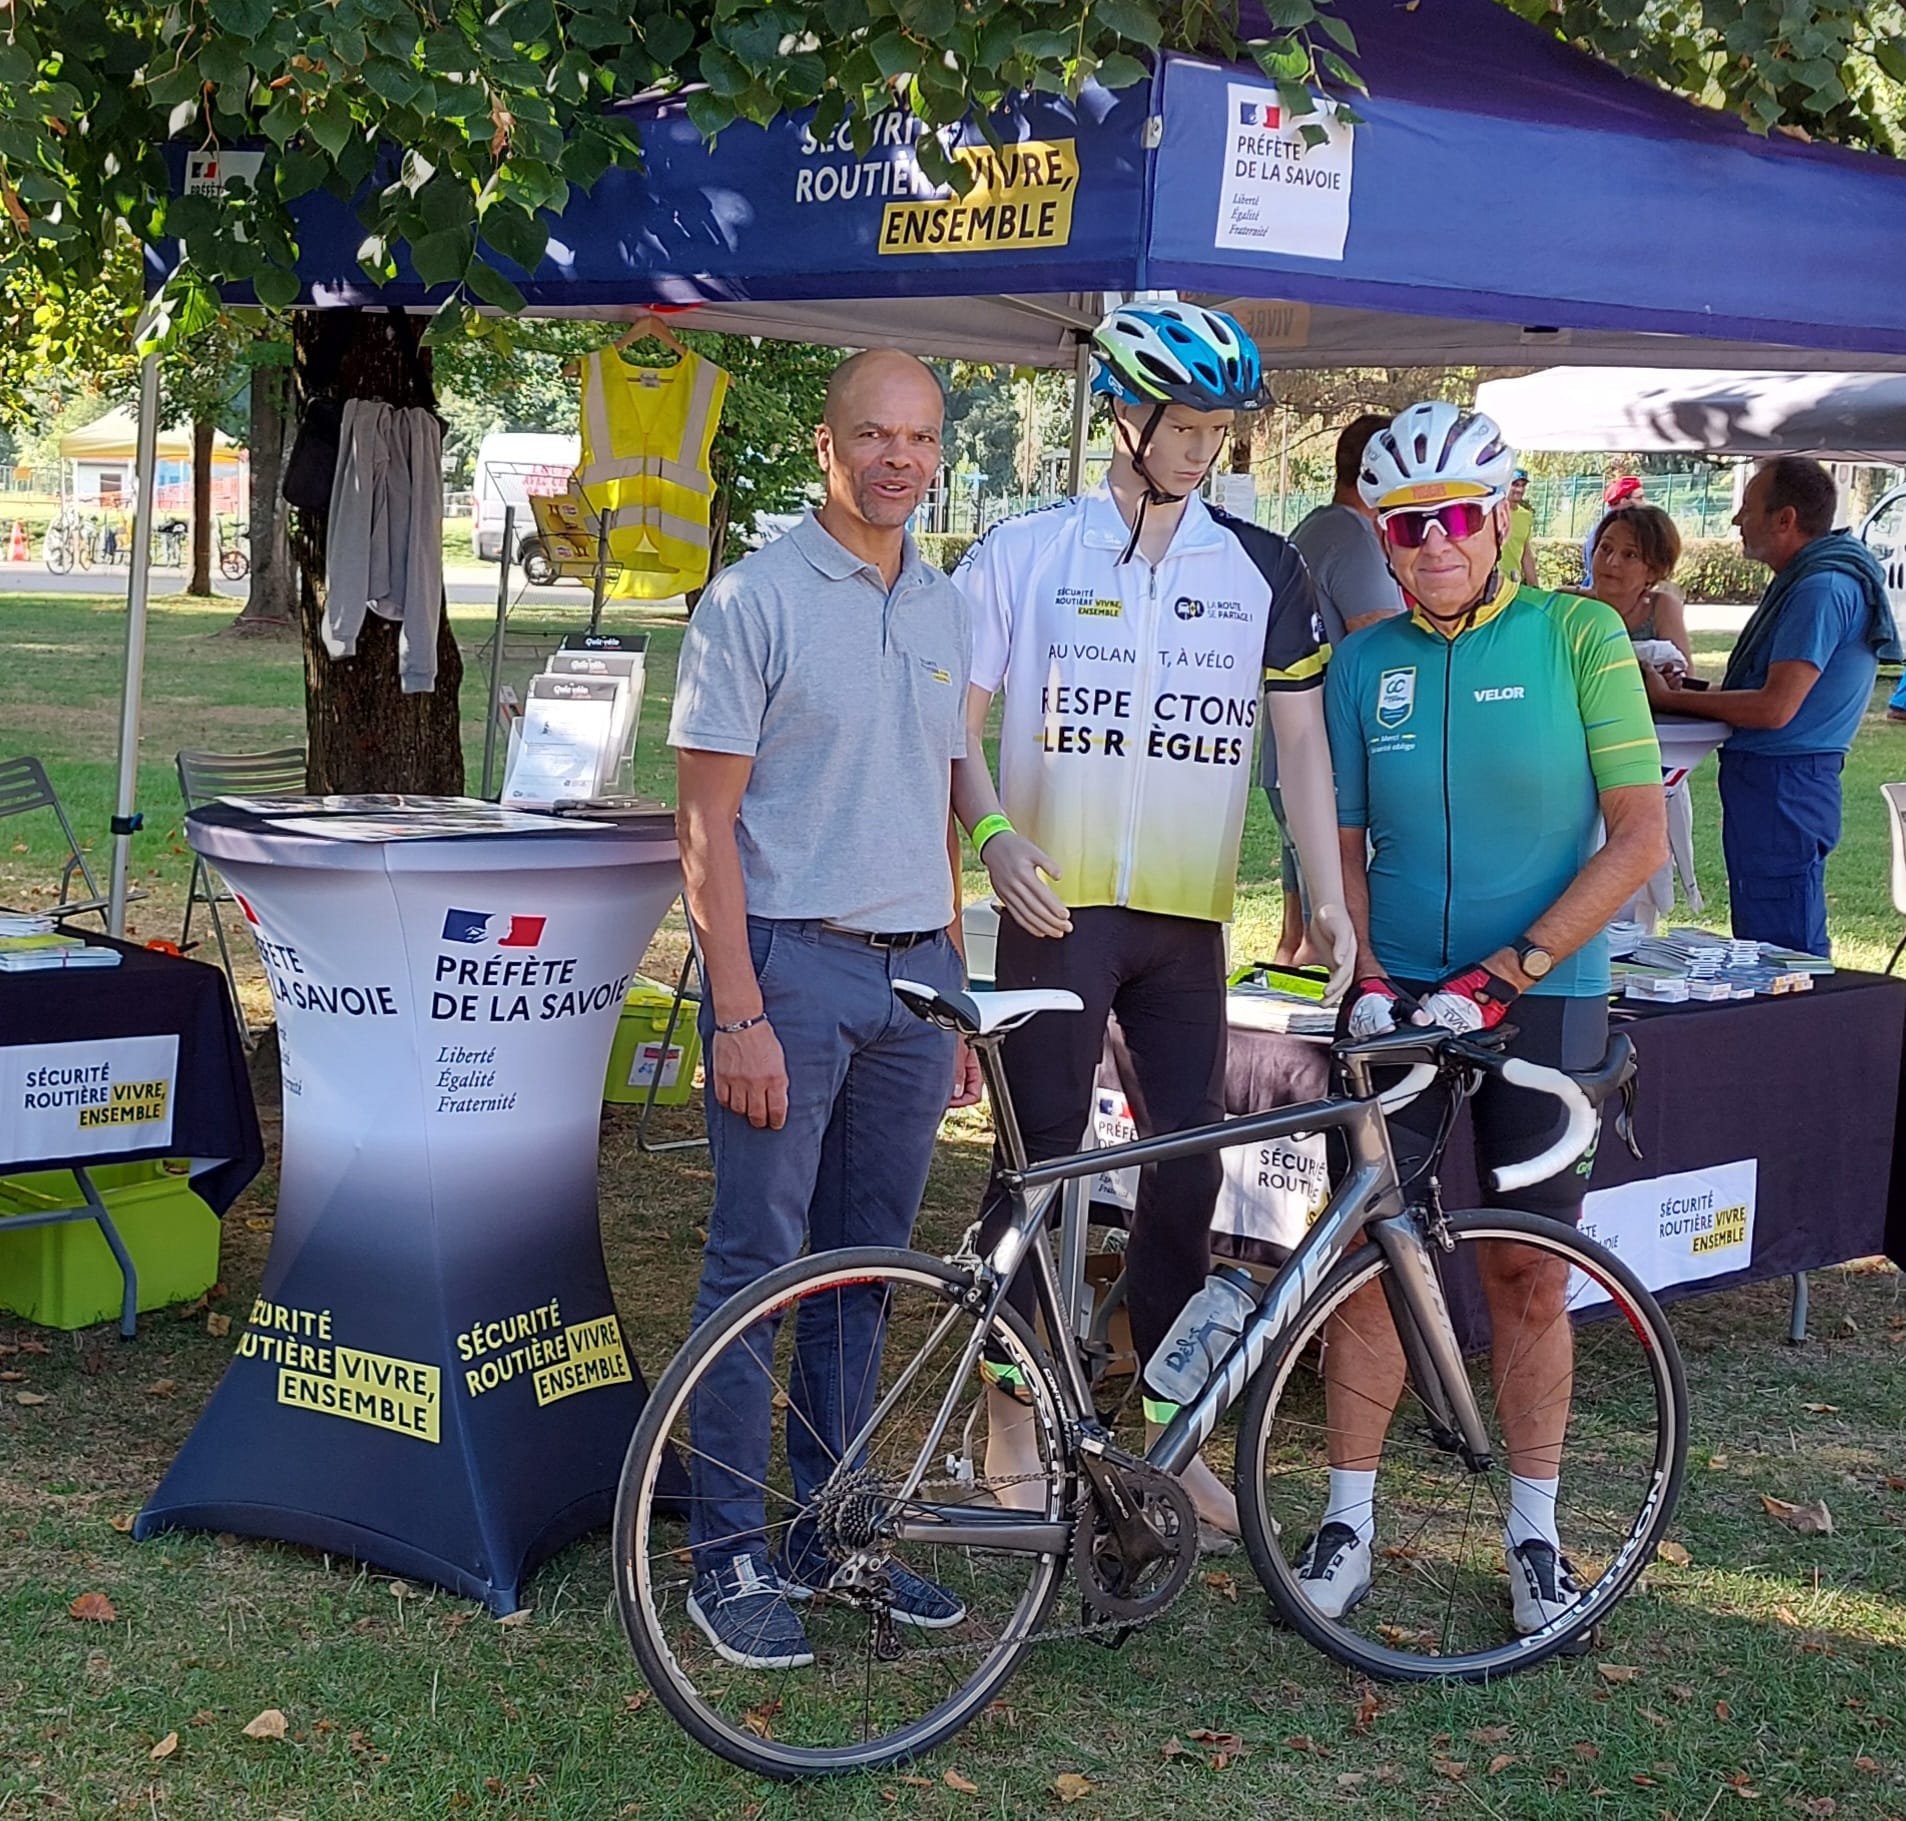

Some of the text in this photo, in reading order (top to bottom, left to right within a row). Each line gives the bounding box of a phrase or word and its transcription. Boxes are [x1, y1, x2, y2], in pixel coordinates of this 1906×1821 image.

[1237, 133, 1301, 161] PRÉFÈTE
[1235, 159, 1341, 190] DE LA SAVOIE
[1232, 193, 1260, 206] Liberté
[885, 201, 1057, 245] ENSEMBLE
[1231, 206, 1260, 222] Égalité
[1229, 224, 1269, 237] Fraternité
[1078, 607, 1119, 617] ENSEMBLE
[1049, 643, 1069, 659] AU
[1176, 648, 1189, 666] À
[1194, 650, 1235, 670] VÉLO
[1474, 687, 1525, 702] VELOR
[1043, 725, 1092, 755] LES
[435, 955, 577, 986] PRÉFÈTE
[292, 980, 398, 1016] SAVOIE
[431, 974, 629, 1021] DE LA SAVOIE
[436, 1047, 496, 1064] Liberté
[26, 1062, 110, 1088] SÉCURITÉ
[436, 1068, 496, 1092] Égalité
[24, 1082, 165, 1109] ROUTIÈRE VIVRE,
[437, 1092, 517, 1112] Fraternité
[79, 1104, 160, 1126] ENSEMBLE
[1660, 1190, 1714, 1218] SÉCURITÉ
[1659, 1212, 1713, 1239] ROUTIÈRE
[1692, 1226, 1745, 1253] ENSEMBLE
[457, 1297, 562, 1361] SÉCURITÉ
[465, 1321, 621, 1398] ROUTIÈRE VIVRE,
[341, 1353, 435, 1403] VIVRE,
[538, 1354, 626, 1400] ENSEMBLE
[284, 1375, 427, 1433] ENSEMBLE
[1519, 1469, 1665, 1648] NEUTRON
